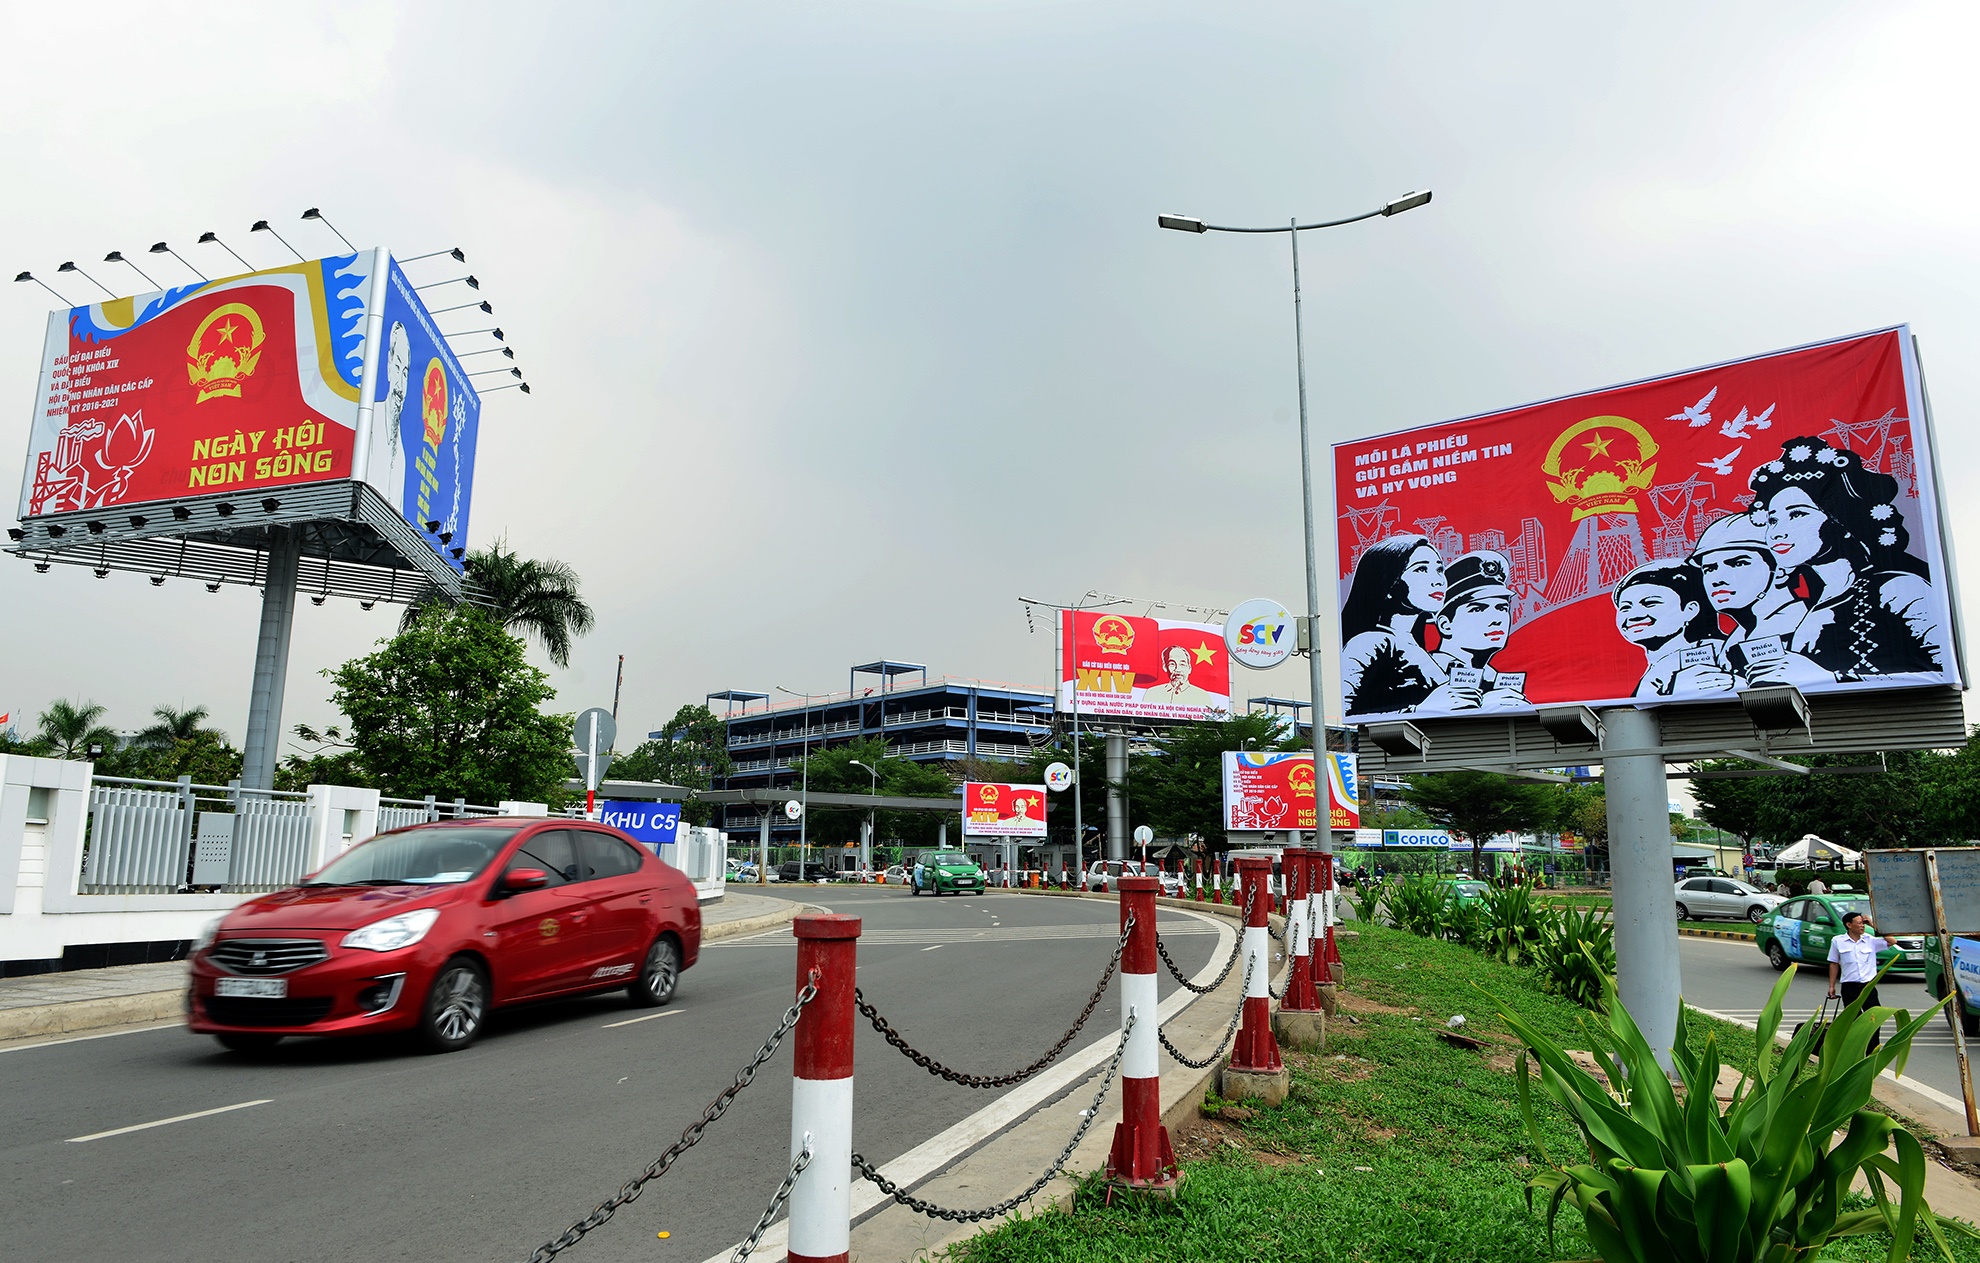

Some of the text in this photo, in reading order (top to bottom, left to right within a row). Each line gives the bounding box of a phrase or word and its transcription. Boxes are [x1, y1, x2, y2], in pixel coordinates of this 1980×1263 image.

[72, 363, 85, 376] HỘI
[86, 361, 105, 374] KHÓA
[106, 358, 120, 370] XIV
[48, 393, 61, 406] HỘI
[82, 386, 103, 399] NHÂN
[104, 384, 120, 396] DÂN
[121, 380, 137, 393] CÁC
[137, 376, 154, 390] CẤP
[50, 382, 60, 392] VÀ
[46, 397, 119, 418] NHIỆM KỲ 2016-2021
[191, 419, 326, 461] NGÀY HỘI
[1391, 443, 1413, 460] LÁ
[1415, 433, 1469, 455] PHIẾU
[188, 460, 246, 488] NON
[254, 449, 333, 480] SÔNG
[1389, 458, 1429, 476] GẮM
[1480, 442, 1513, 460] TIN
[1355, 470, 1458, 499] VÀ HY VỌNG
[1238, 622, 1286, 646] SCTV
[1076, 668, 1136, 694] XIV
[603, 811, 677, 830] KHU C5
[971, 811, 1000, 823] XIV
[1401, 834, 1449, 846] COFICO
